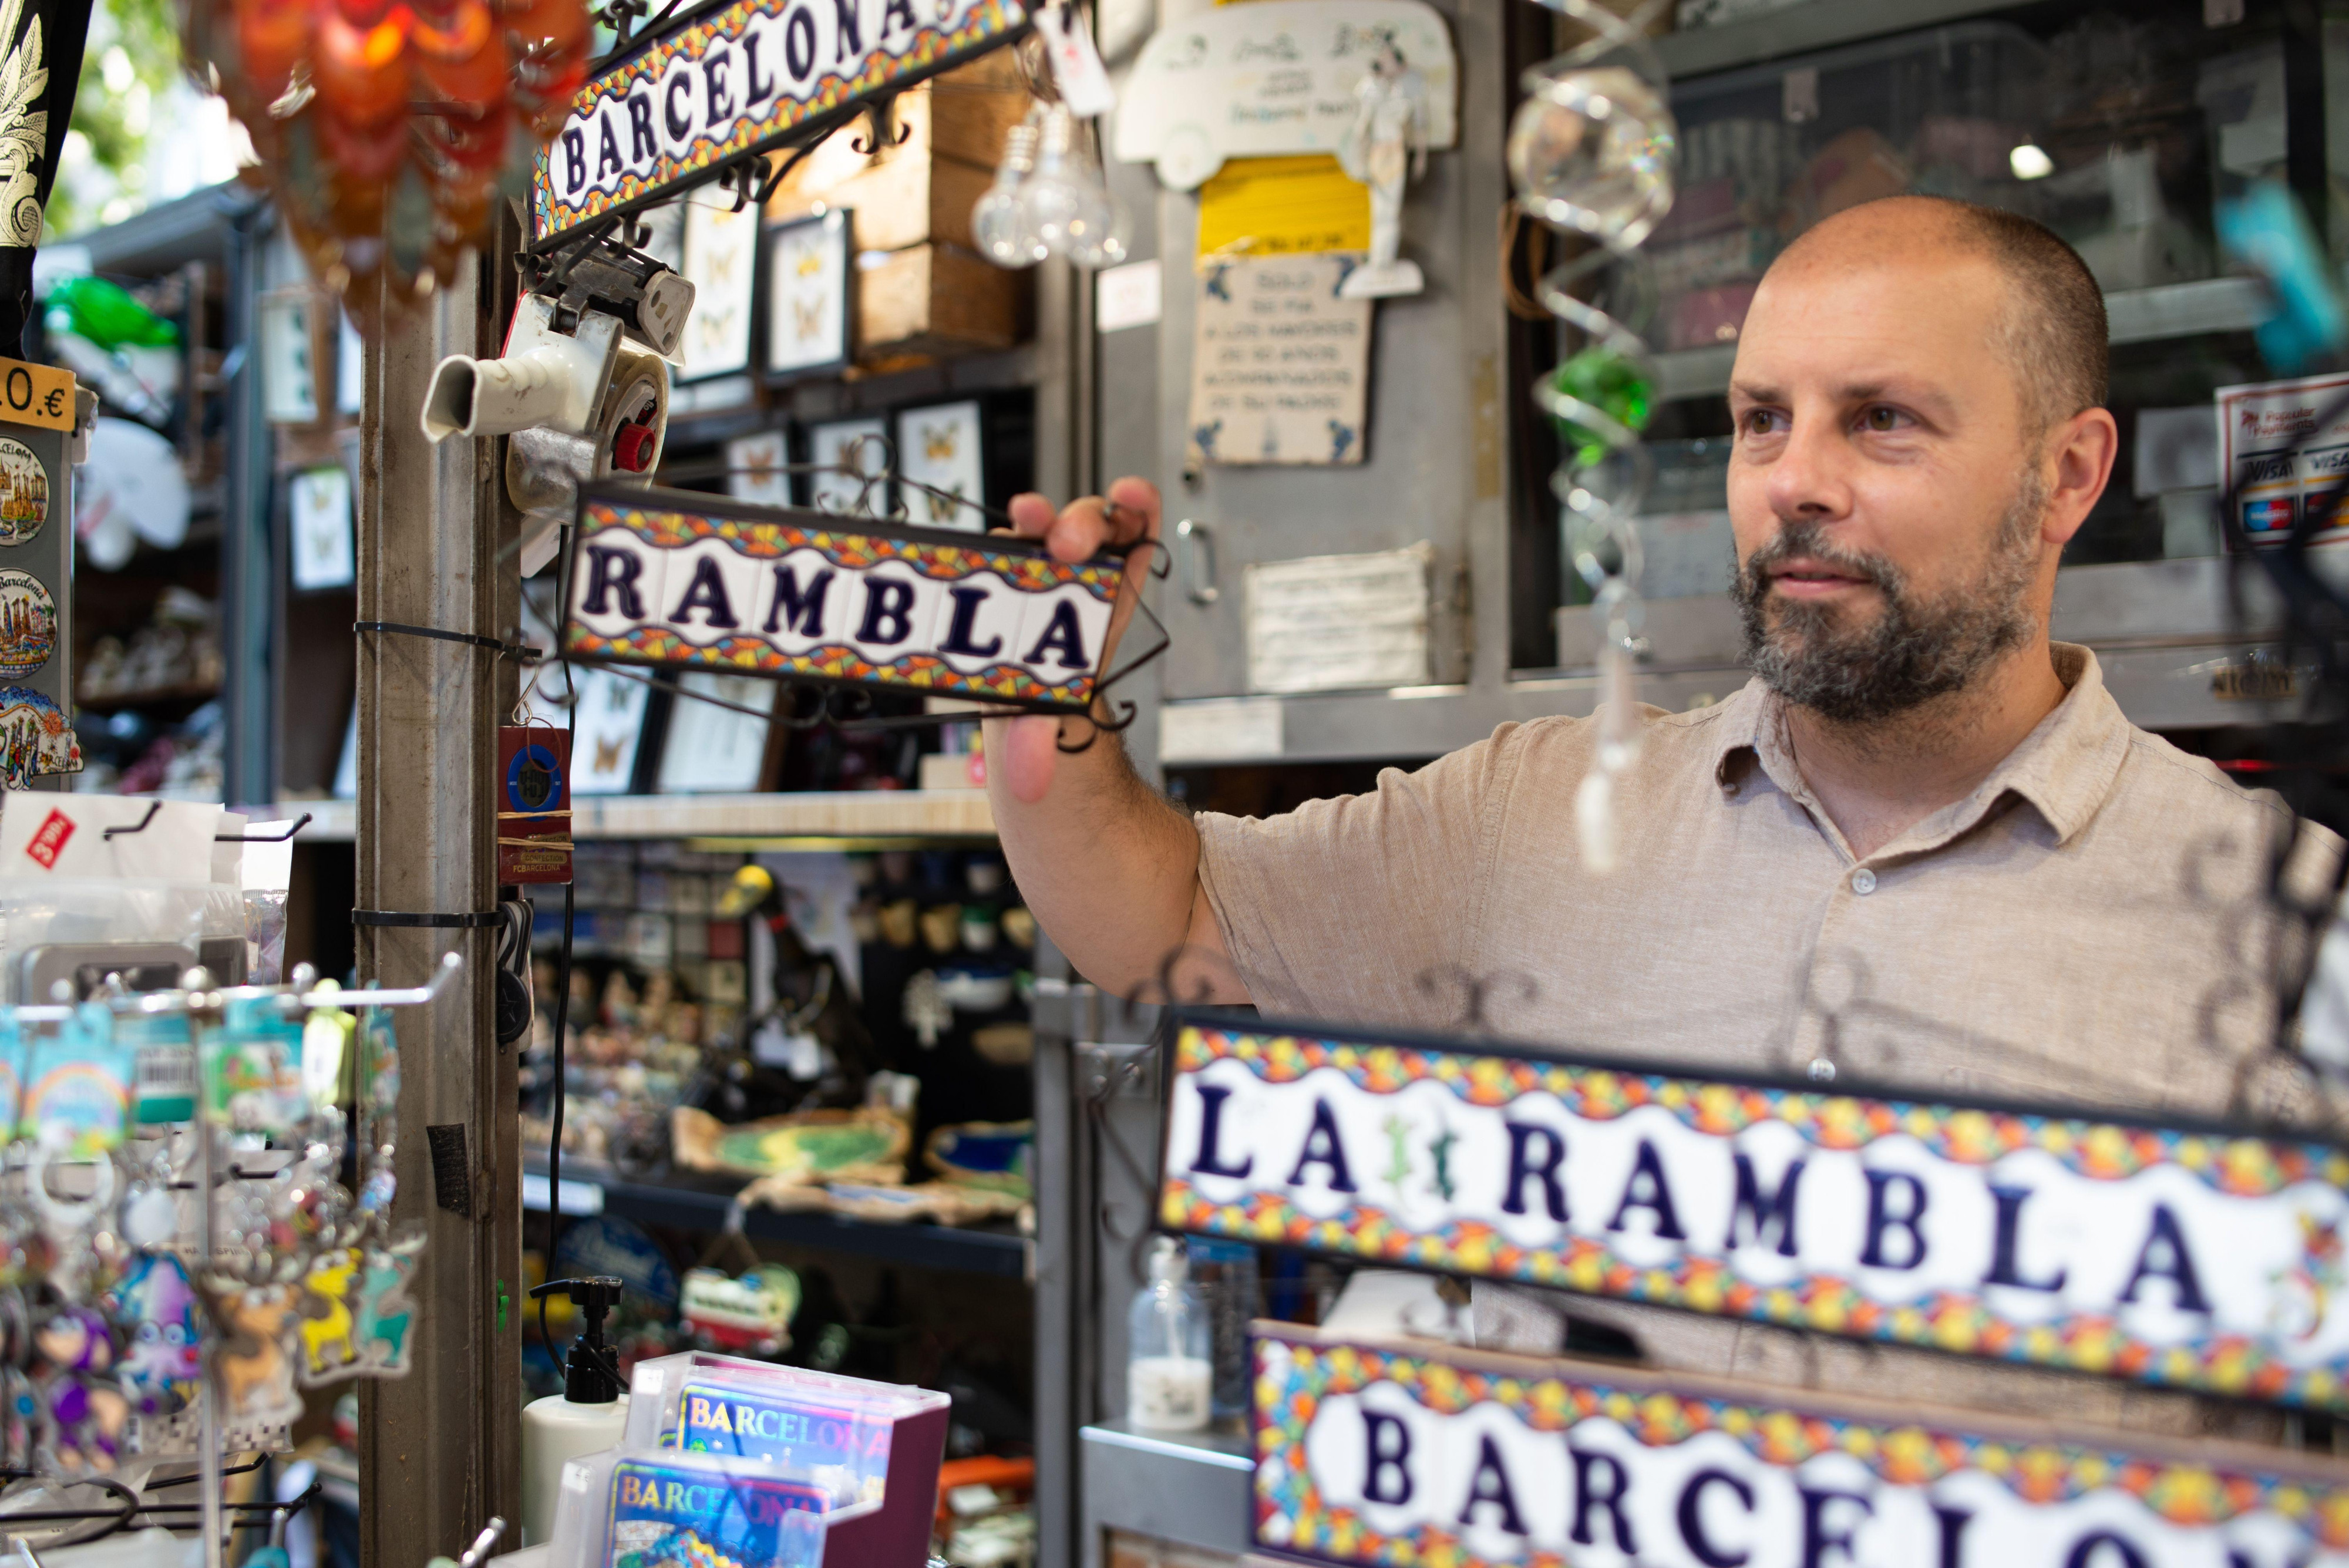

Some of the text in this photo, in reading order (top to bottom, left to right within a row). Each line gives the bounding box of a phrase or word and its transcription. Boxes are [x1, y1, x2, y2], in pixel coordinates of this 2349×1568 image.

[2249, 458, 2294, 482] VISA
[581, 545, 1089, 669] RAMBLA
[1189, 1083, 2216, 1314] LA RAMBLA
[689, 1397, 890, 1457] BARCELONA
